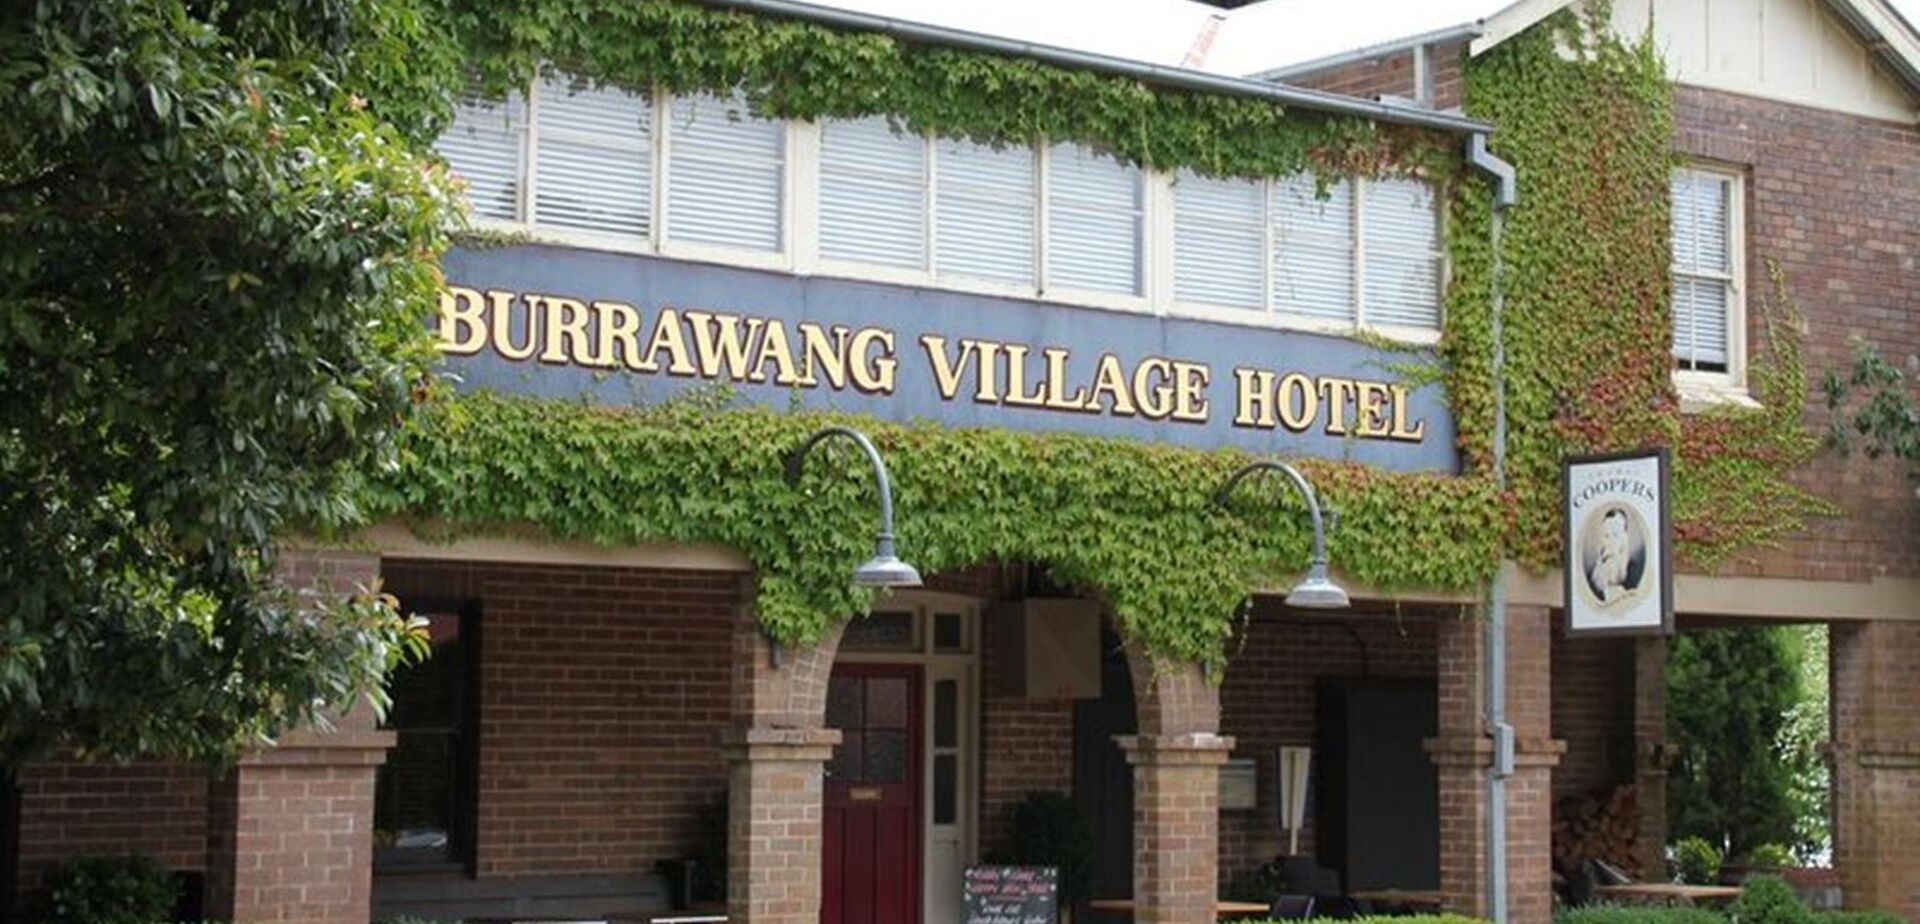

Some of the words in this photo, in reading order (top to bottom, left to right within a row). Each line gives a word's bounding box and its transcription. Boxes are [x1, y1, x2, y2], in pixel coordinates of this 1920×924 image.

[434, 284, 898, 395] BURRAWANG
[919, 334, 1210, 424] VILLAGE
[1233, 366, 1426, 443] HOTEL
[1573, 478, 1655, 508] COOPERS
